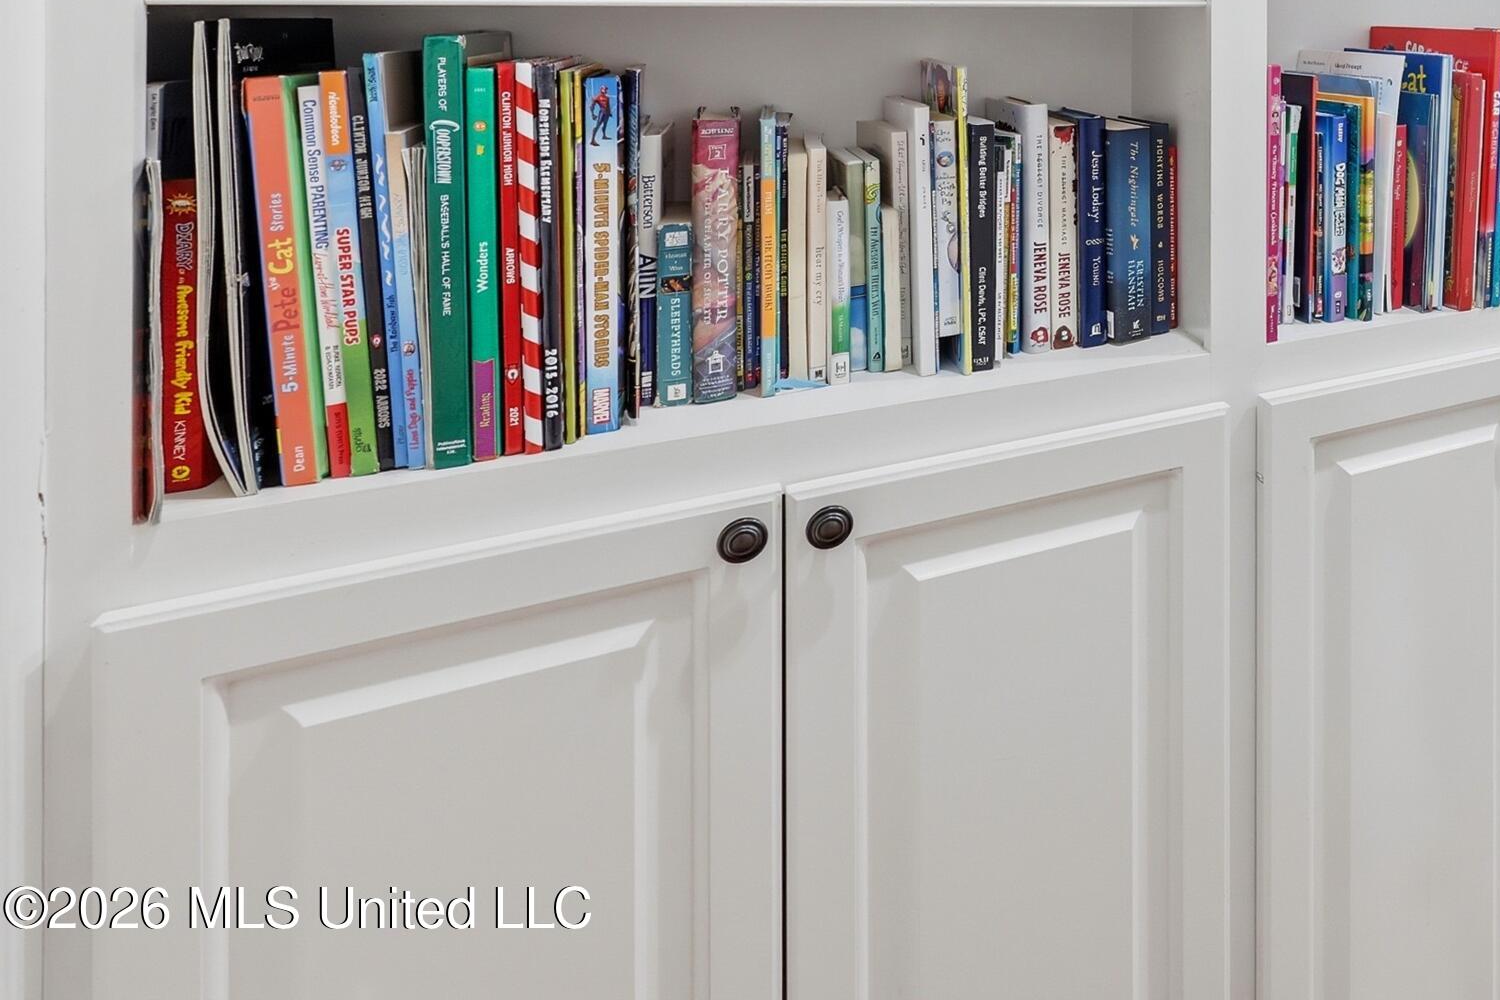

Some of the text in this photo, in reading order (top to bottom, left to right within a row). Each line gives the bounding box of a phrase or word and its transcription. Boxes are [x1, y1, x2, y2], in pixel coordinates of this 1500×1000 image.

[1402, 65, 1427, 94] at
[1492, 91, 1500, 116] CAR
[327, 91, 343, 147] nickelodeon
[301, 99, 329, 249] Common Sense PARENTING
[352, 115, 373, 219] CLINTON JUNIOR HIGH
[429, 57, 460, 316] PLAYERS OF COOPERSTOWN BASEBALL'S HALL OF FAME
[977, 136, 987, 219] Building Better Bridges
[1091, 151, 1103, 180] Jesus
[1128, 141, 1140, 228] The Nightingale
[1156, 139, 1164, 187] FIGHTING
[1334, 162, 1346, 185] DOG
[269, 193, 285, 231] Stories
[641, 175, 656, 229] Batterson
[1334, 186, 1345, 208] MAN
[267, 237, 295, 274] Cat
[475, 242, 489, 293] Wonders
[501, 92, 519, 427] CLINTON JUNIOR HIGH ARROWS 2021
[593, 231, 610, 311] SPIDER-MAN
[813, 247, 825, 305] hear my cry
[978, 267, 987, 284] Clint
[1033, 242, 1047, 314] JENEVA ROSE
[337, 228, 360, 345] SUPER STAR PUPS
[386, 294, 396, 309] Fish
[715, 249, 730, 323] POTTER
[1058, 252, 1071, 319] JENEVA ROSE
[1127, 260, 1135, 311] HANNAH
[1136, 259, 1144, 308] KRISTIN
[176, 285, 193, 337] Awesome
[271, 288, 300, 333] Pete
[388, 311, 399, 340] Rainbow
[593, 315, 611, 368] STORIES
[670, 298, 682, 377] SLEEPYHEADS
[171, 341, 194, 389] Friendly
[374, 368, 386, 392] 2022
[174, 392, 194, 415] Kid
[592, 388, 611, 425] MARVEL
[173, 420, 187, 461] KINNEY
[293, 446, 306, 472] Dean
